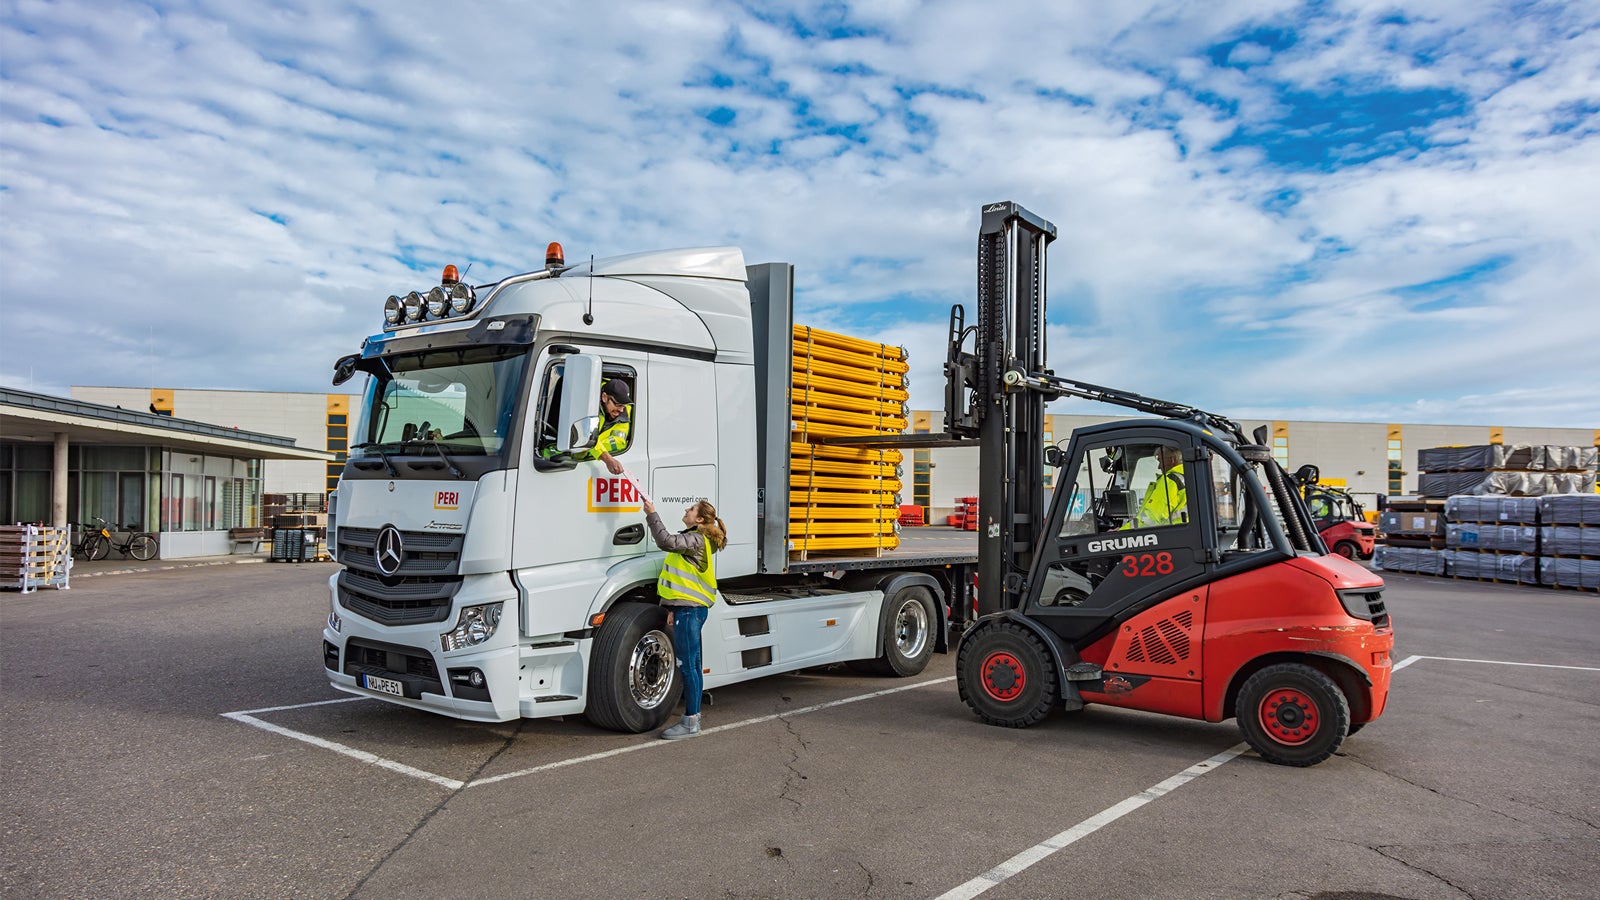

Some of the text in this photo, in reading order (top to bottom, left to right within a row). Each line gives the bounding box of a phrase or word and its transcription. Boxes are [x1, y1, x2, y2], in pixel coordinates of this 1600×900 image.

[984, 204, 1007, 213] Linde
[437, 491, 459, 505] PERI
[1087, 534, 1159, 553] GRUMA
[1122, 551, 1174, 577] 328
